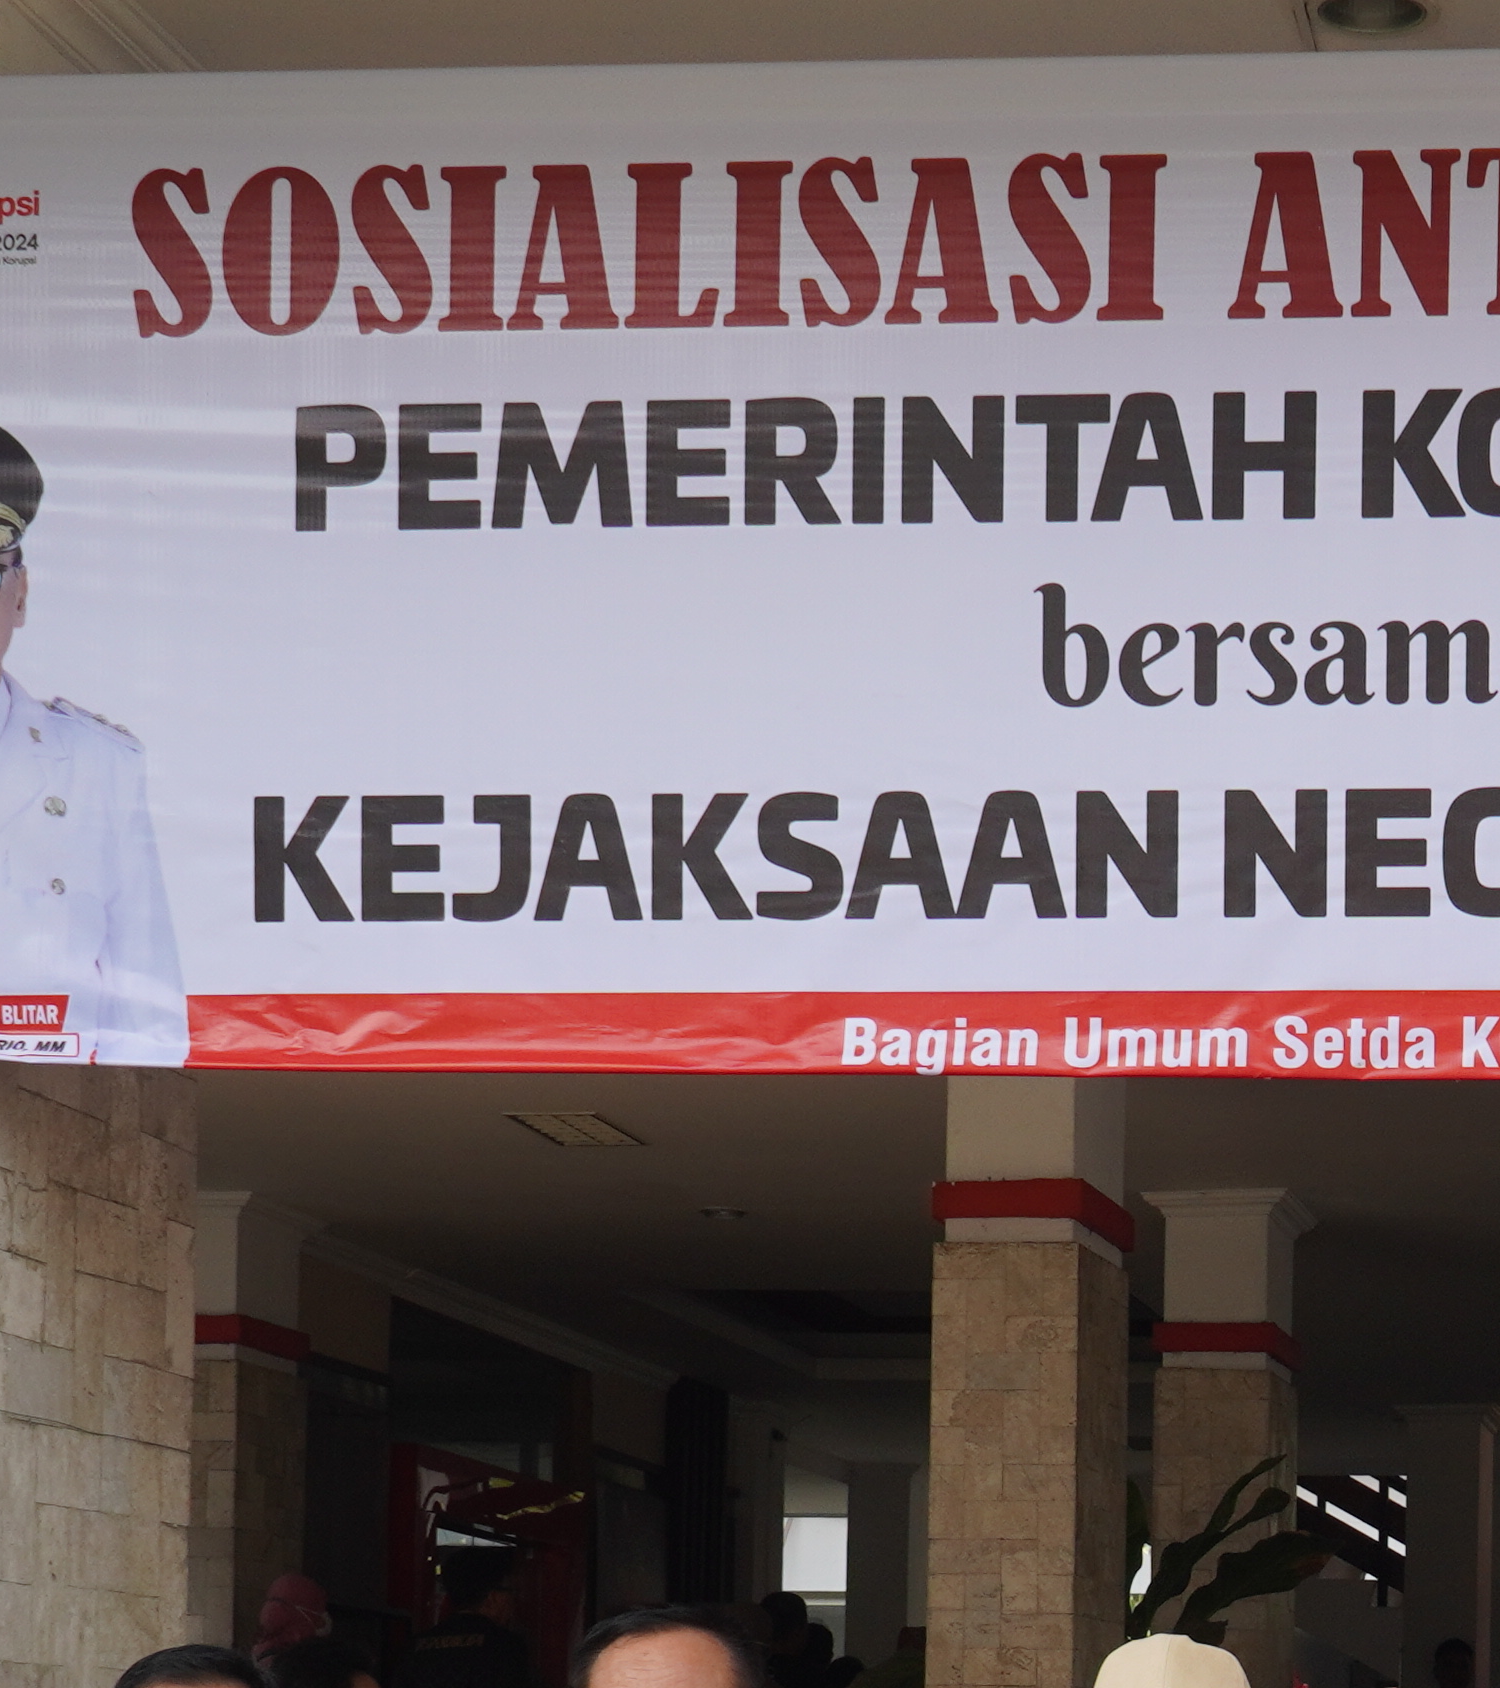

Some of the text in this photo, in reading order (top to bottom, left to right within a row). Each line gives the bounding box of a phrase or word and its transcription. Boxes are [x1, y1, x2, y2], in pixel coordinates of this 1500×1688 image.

[131, 152, 1168, 338] SOSIALISASI
[295, 390, 1317, 532] PEMERINTAH
[252, 788, 1179, 923] KEJAKSAAN
[1, 1004, 59, 1025] BLITAR
[34, 1040, 67, 1053] MM
[840, 1016, 1039, 1076] Bagian
[1064, 1017, 1247, 1068] Umum
[1273, 1017, 1437, 1069] Setda
